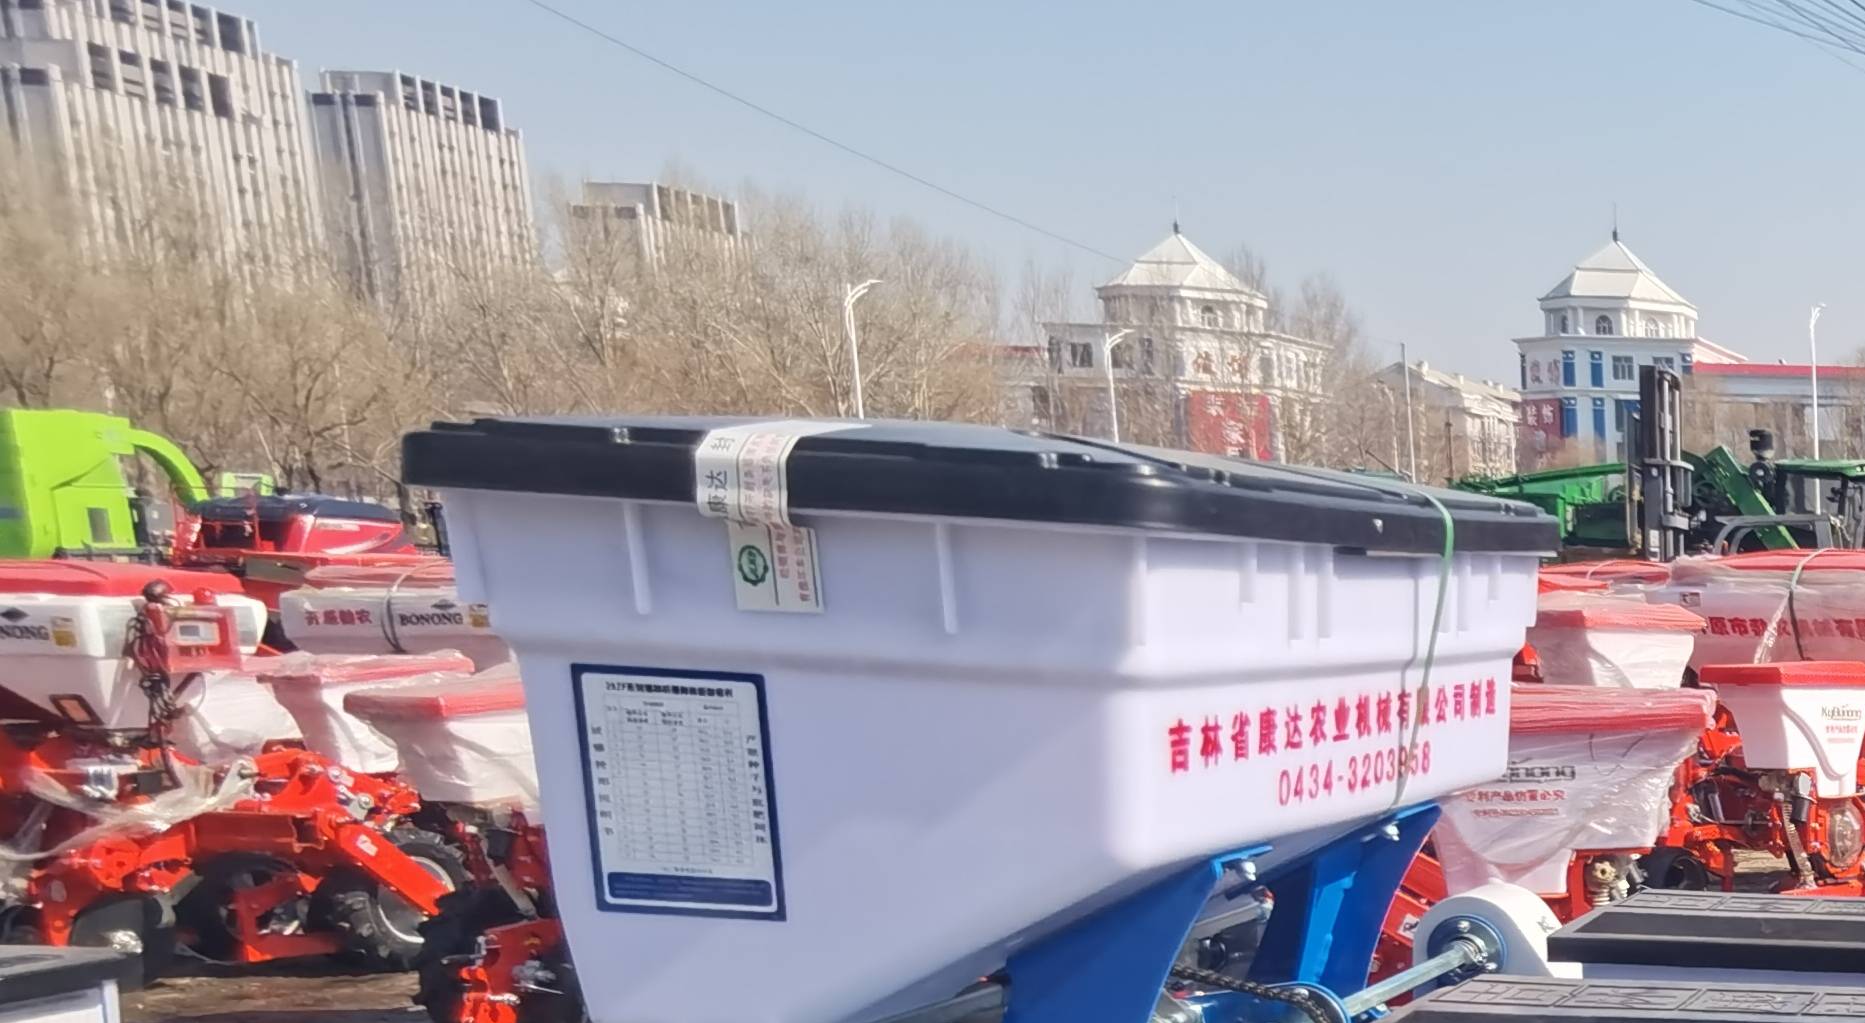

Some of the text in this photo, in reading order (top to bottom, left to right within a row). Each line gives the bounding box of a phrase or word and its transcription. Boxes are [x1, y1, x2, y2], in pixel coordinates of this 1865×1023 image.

[400, 613, 464, 626] BONONG
[1168, 678, 1497, 774] 吉林省康达农业机械有限公司制造
